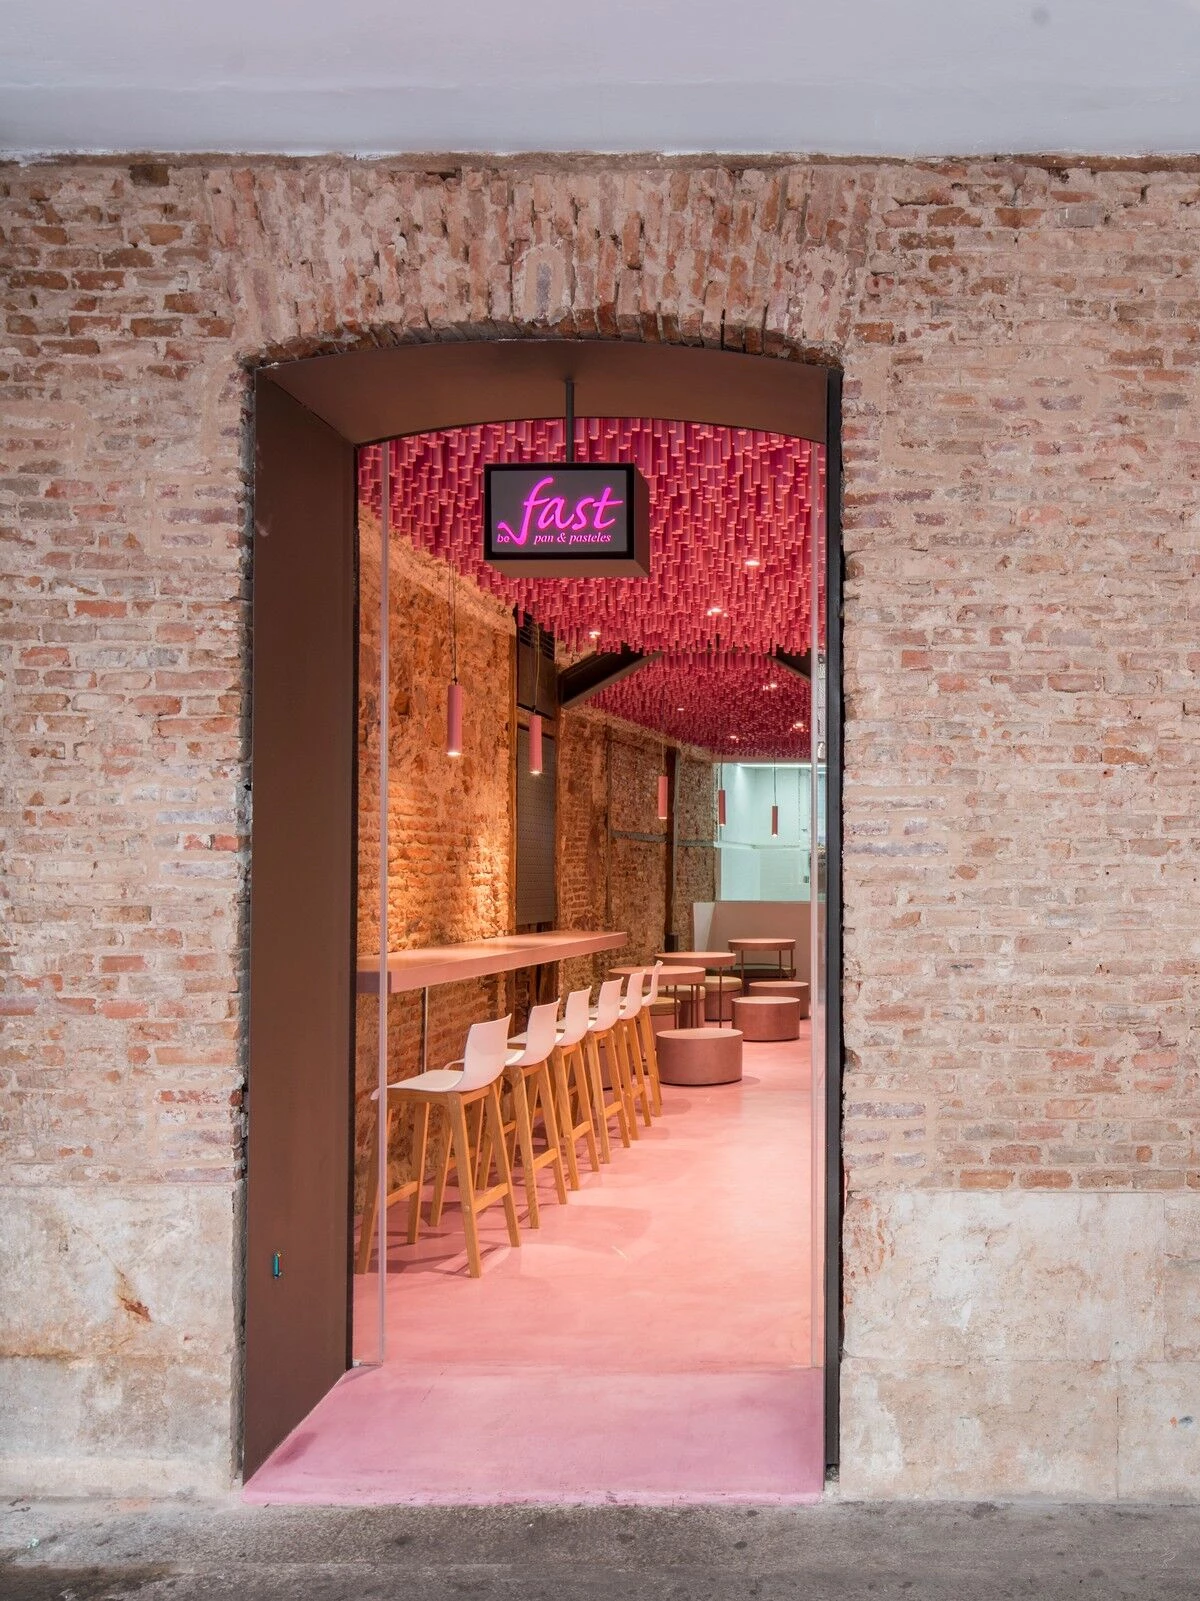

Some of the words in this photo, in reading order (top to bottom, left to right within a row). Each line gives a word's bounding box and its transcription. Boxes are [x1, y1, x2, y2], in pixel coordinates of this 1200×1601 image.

[497, 477, 624, 546] fast
[533, 534, 554, 545] pan
[556, 532, 567, 543] &
[569, 532, 612, 545] pasteles
